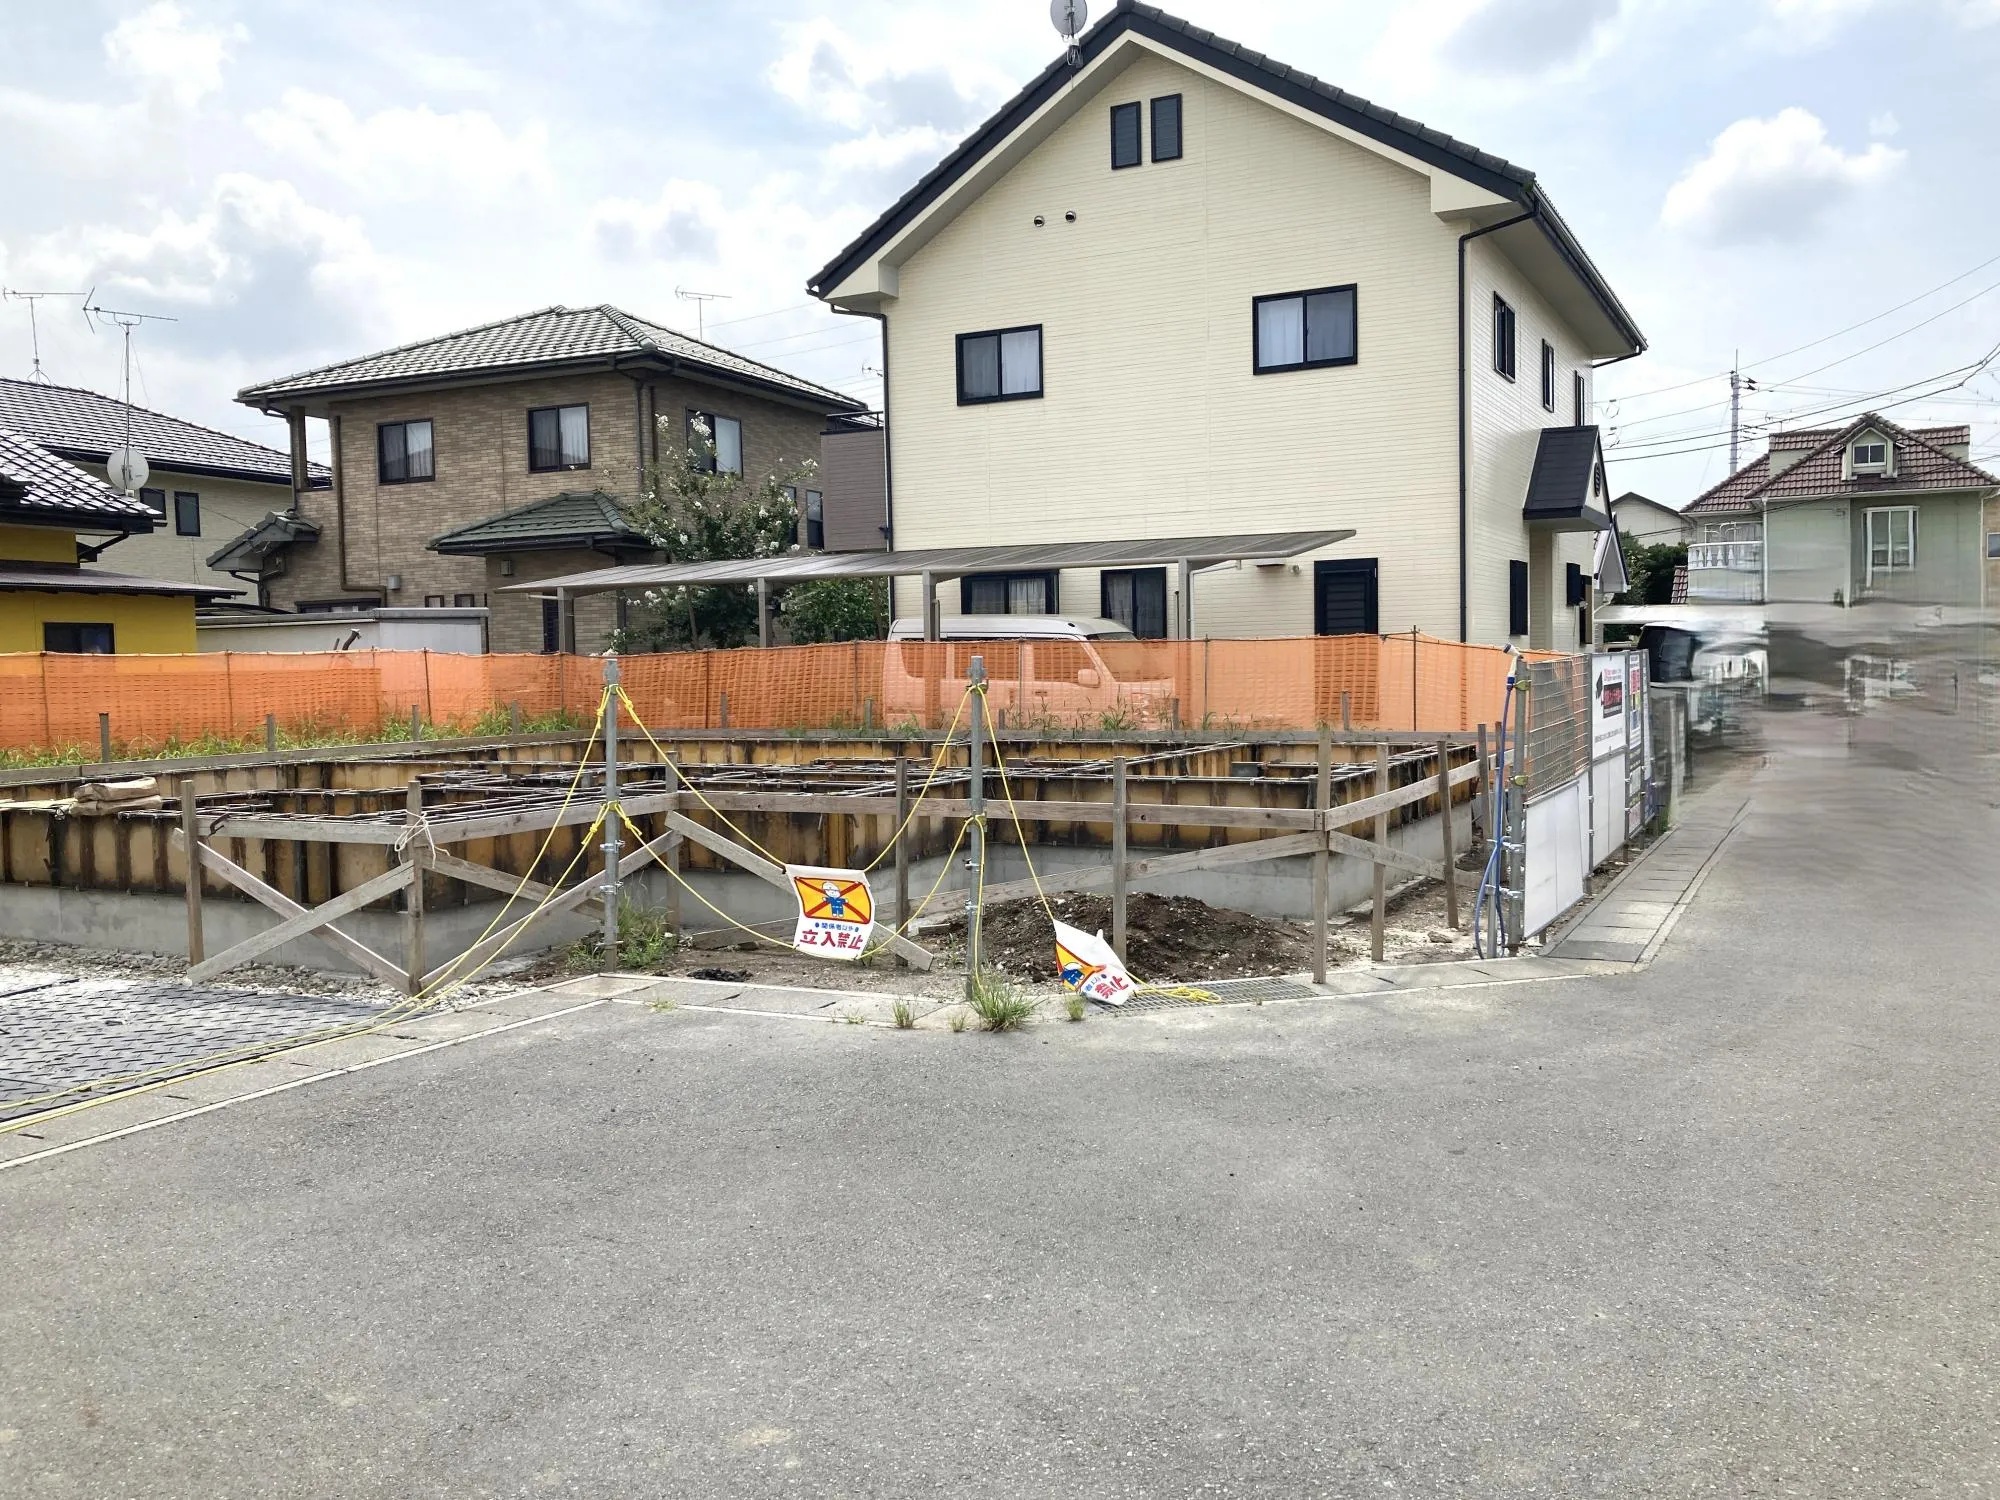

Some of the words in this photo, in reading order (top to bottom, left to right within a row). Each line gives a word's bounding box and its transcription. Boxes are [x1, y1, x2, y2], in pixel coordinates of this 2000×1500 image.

[800, 929, 863, 950] 立入禁止
[1095, 975, 1129, 999] 禁止
